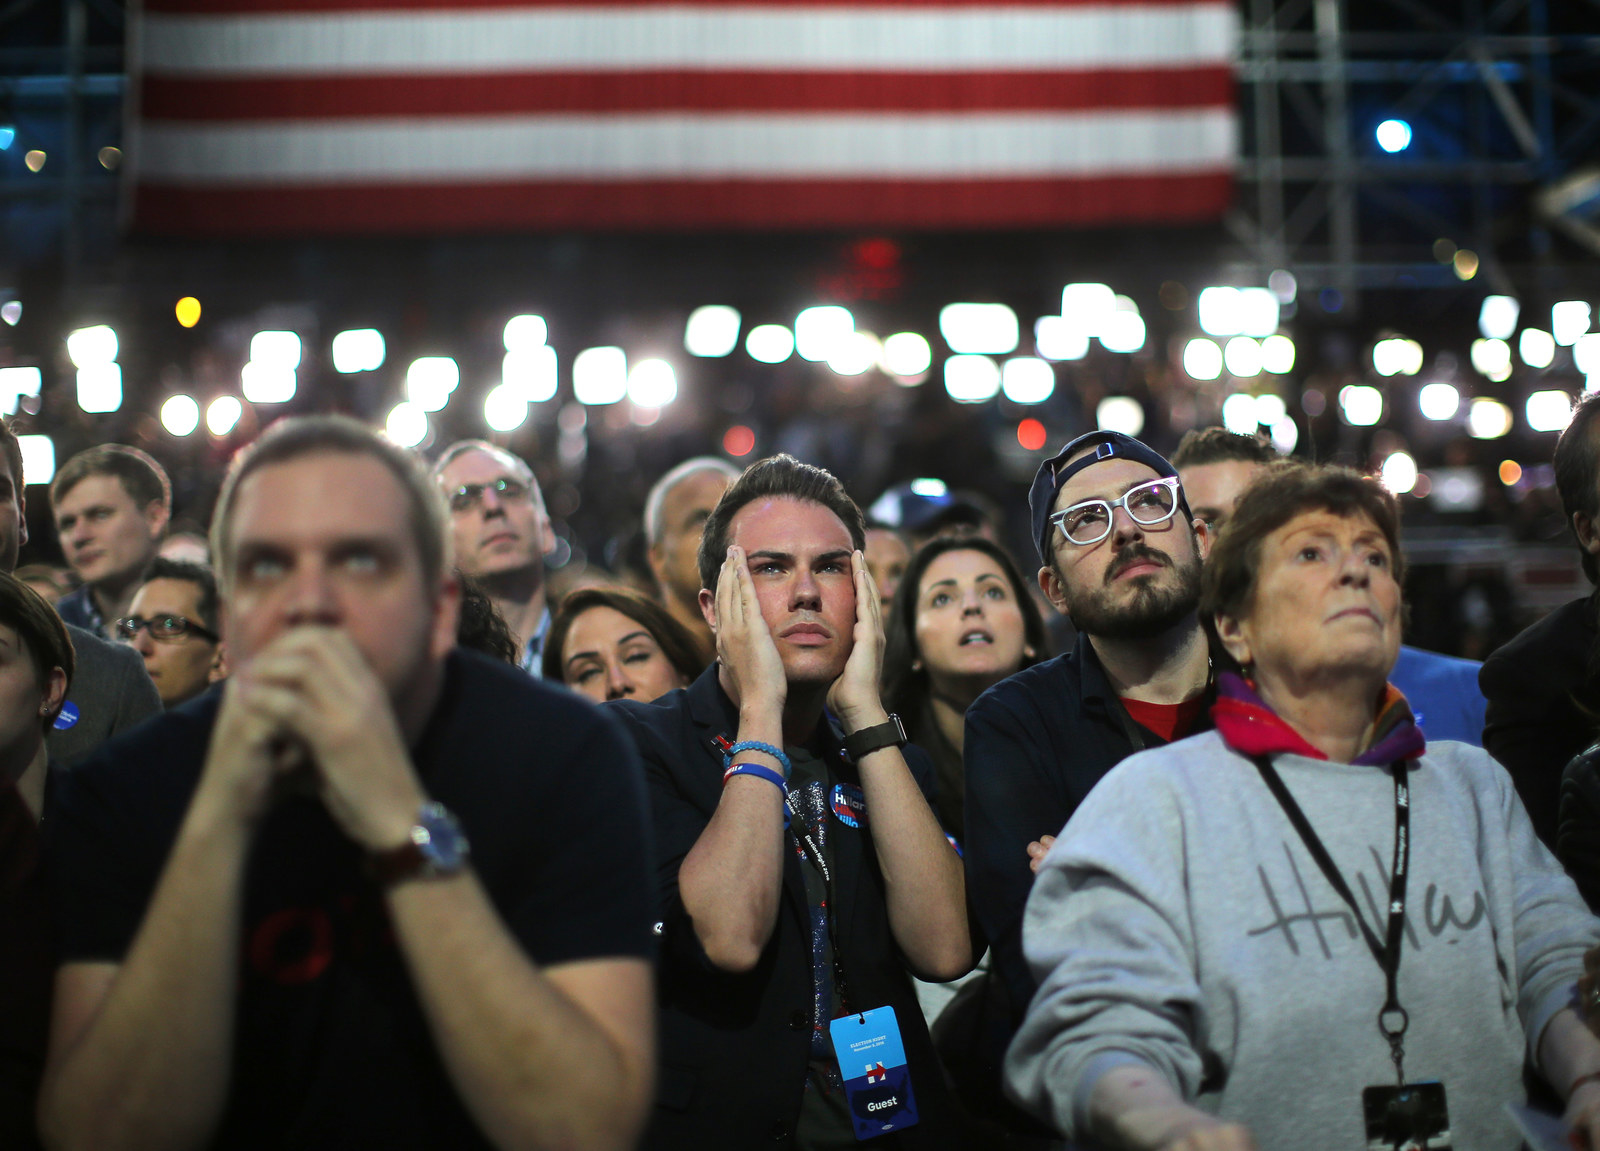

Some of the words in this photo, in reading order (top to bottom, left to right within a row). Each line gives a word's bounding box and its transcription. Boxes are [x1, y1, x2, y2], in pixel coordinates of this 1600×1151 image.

[835, 792, 865, 811] Hillar
[805, 834, 819, 854] Election
[816, 852, 826, 868] Night
[867, 1096, 898, 1112] Guest
